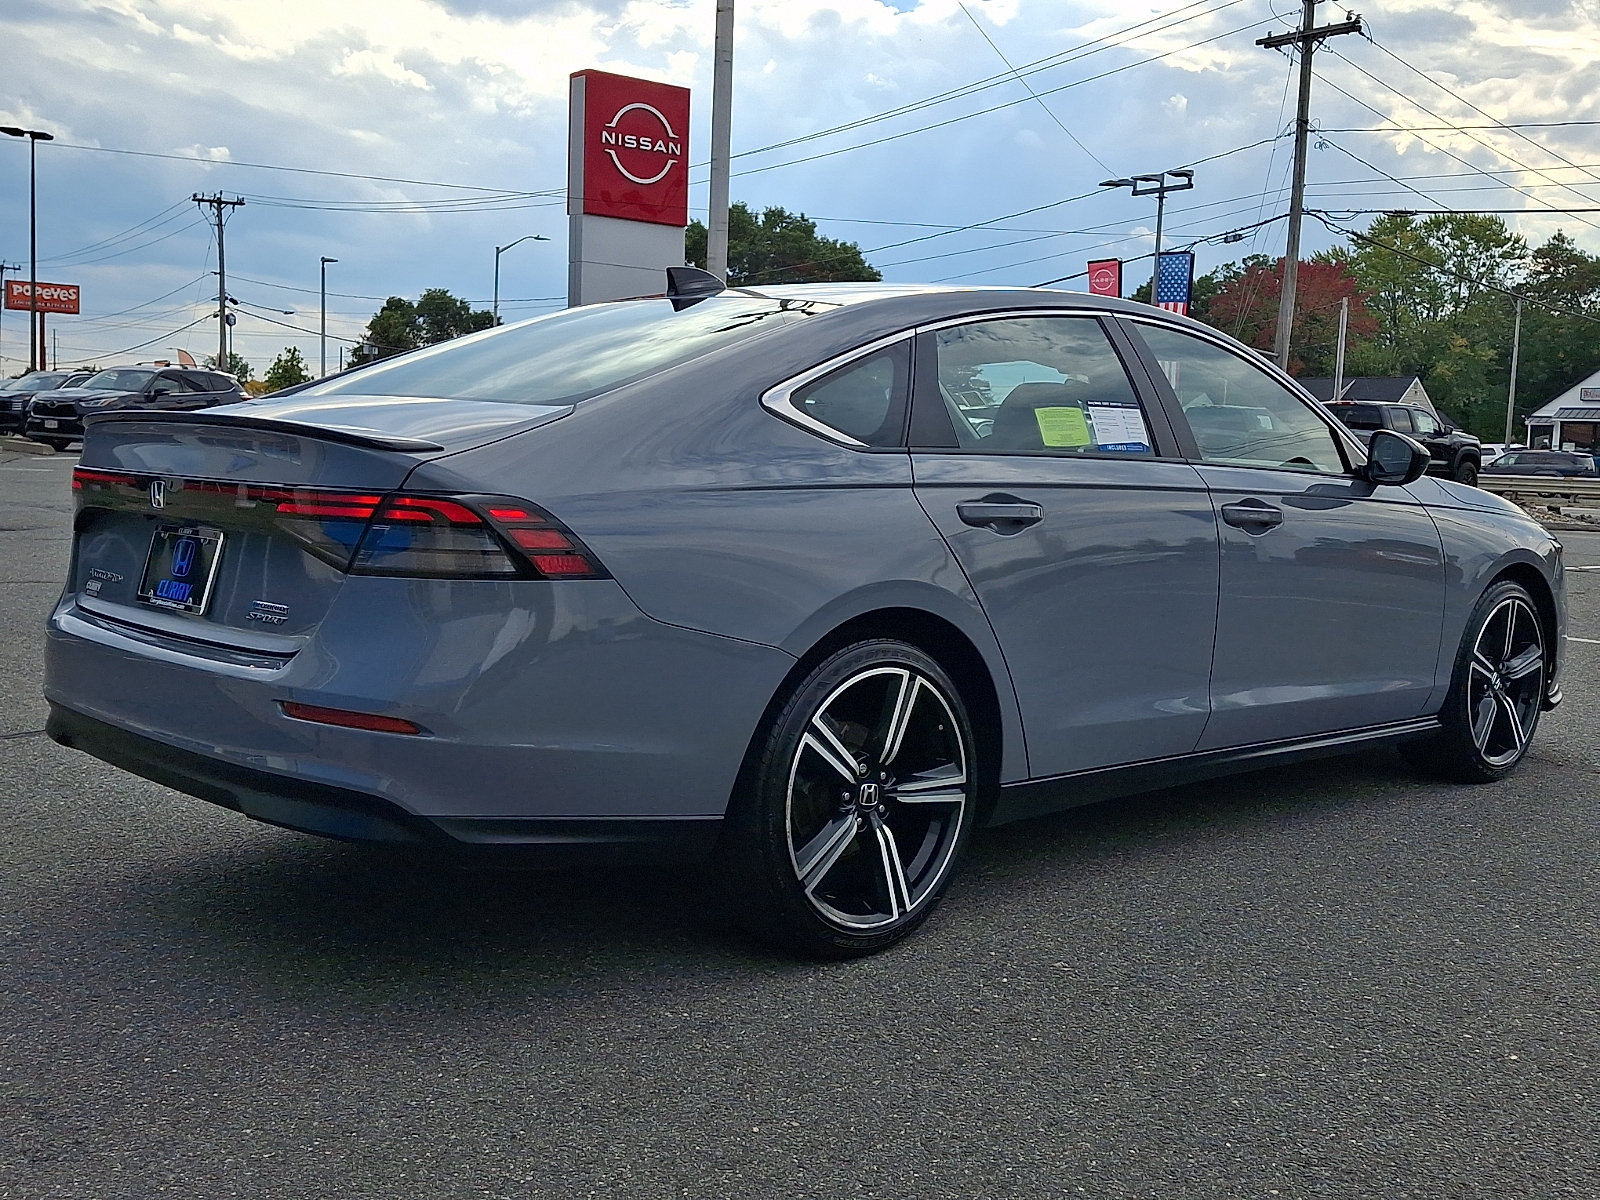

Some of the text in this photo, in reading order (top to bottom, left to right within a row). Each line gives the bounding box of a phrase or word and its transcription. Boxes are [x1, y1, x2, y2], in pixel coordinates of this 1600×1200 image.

[602, 131, 681, 156] NISSAN
[157, 580, 193, 601] CURRY
[246, 612, 288, 625] SPORT
